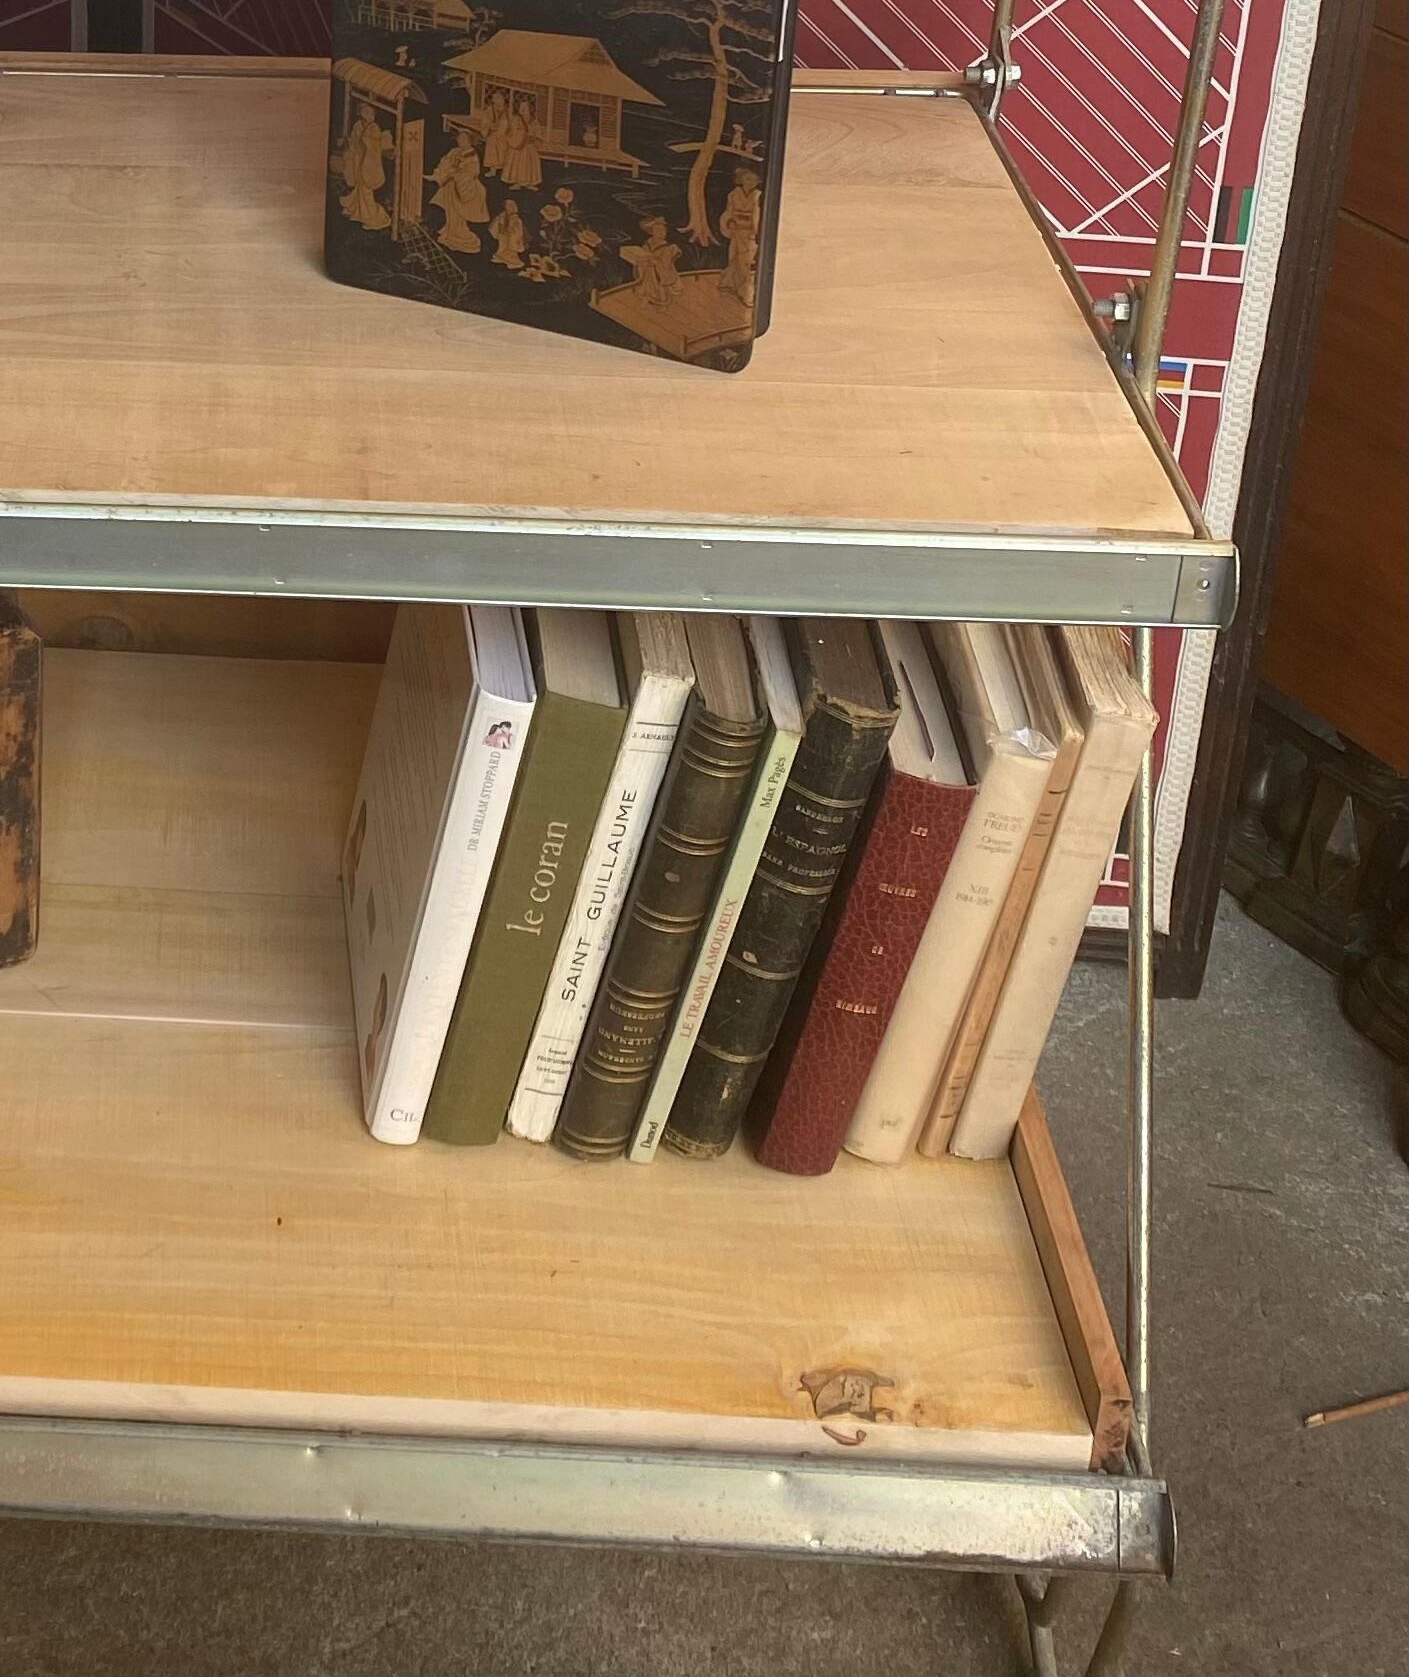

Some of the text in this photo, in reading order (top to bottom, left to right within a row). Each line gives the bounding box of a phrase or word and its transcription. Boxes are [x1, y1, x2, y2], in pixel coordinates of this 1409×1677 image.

[464, 749, 503, 852] DR MIRIAM STOPPARD
[758, 754, 788, 809] Max Pagès
[505, 816, 571, 938] le coran
[559, 936, 593, 1003] SAINT
[584, 787, 638, 921] GUILLAUME
[678, 897, 738, 1038] LE TRAVAIL AMOUREUX
